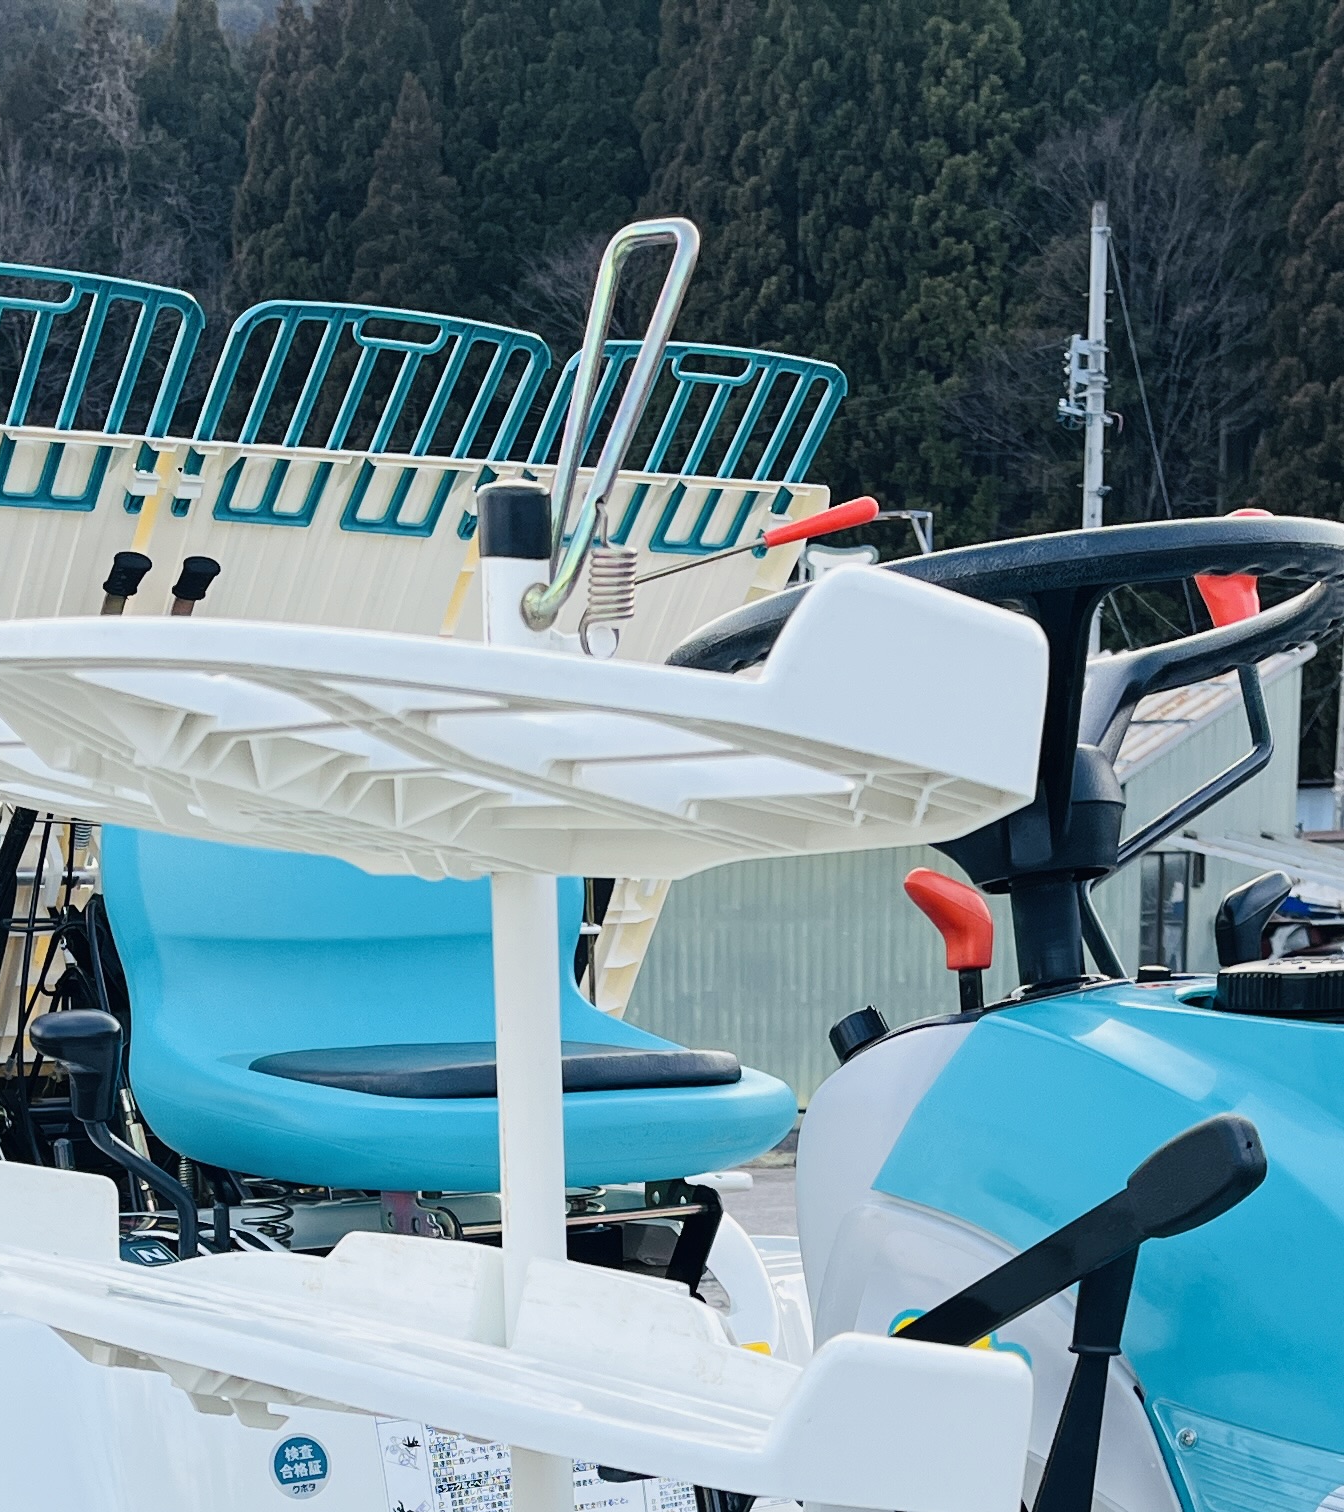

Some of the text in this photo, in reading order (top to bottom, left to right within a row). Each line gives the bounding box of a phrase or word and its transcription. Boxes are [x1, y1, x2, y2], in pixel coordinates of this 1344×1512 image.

[137, 1248, 169, 1262] N
[284, 1444, 315, 1462] 検査
[279, 1459, 323, 1479] 合格証
[292, 1483, 316, 1494] クボタ
